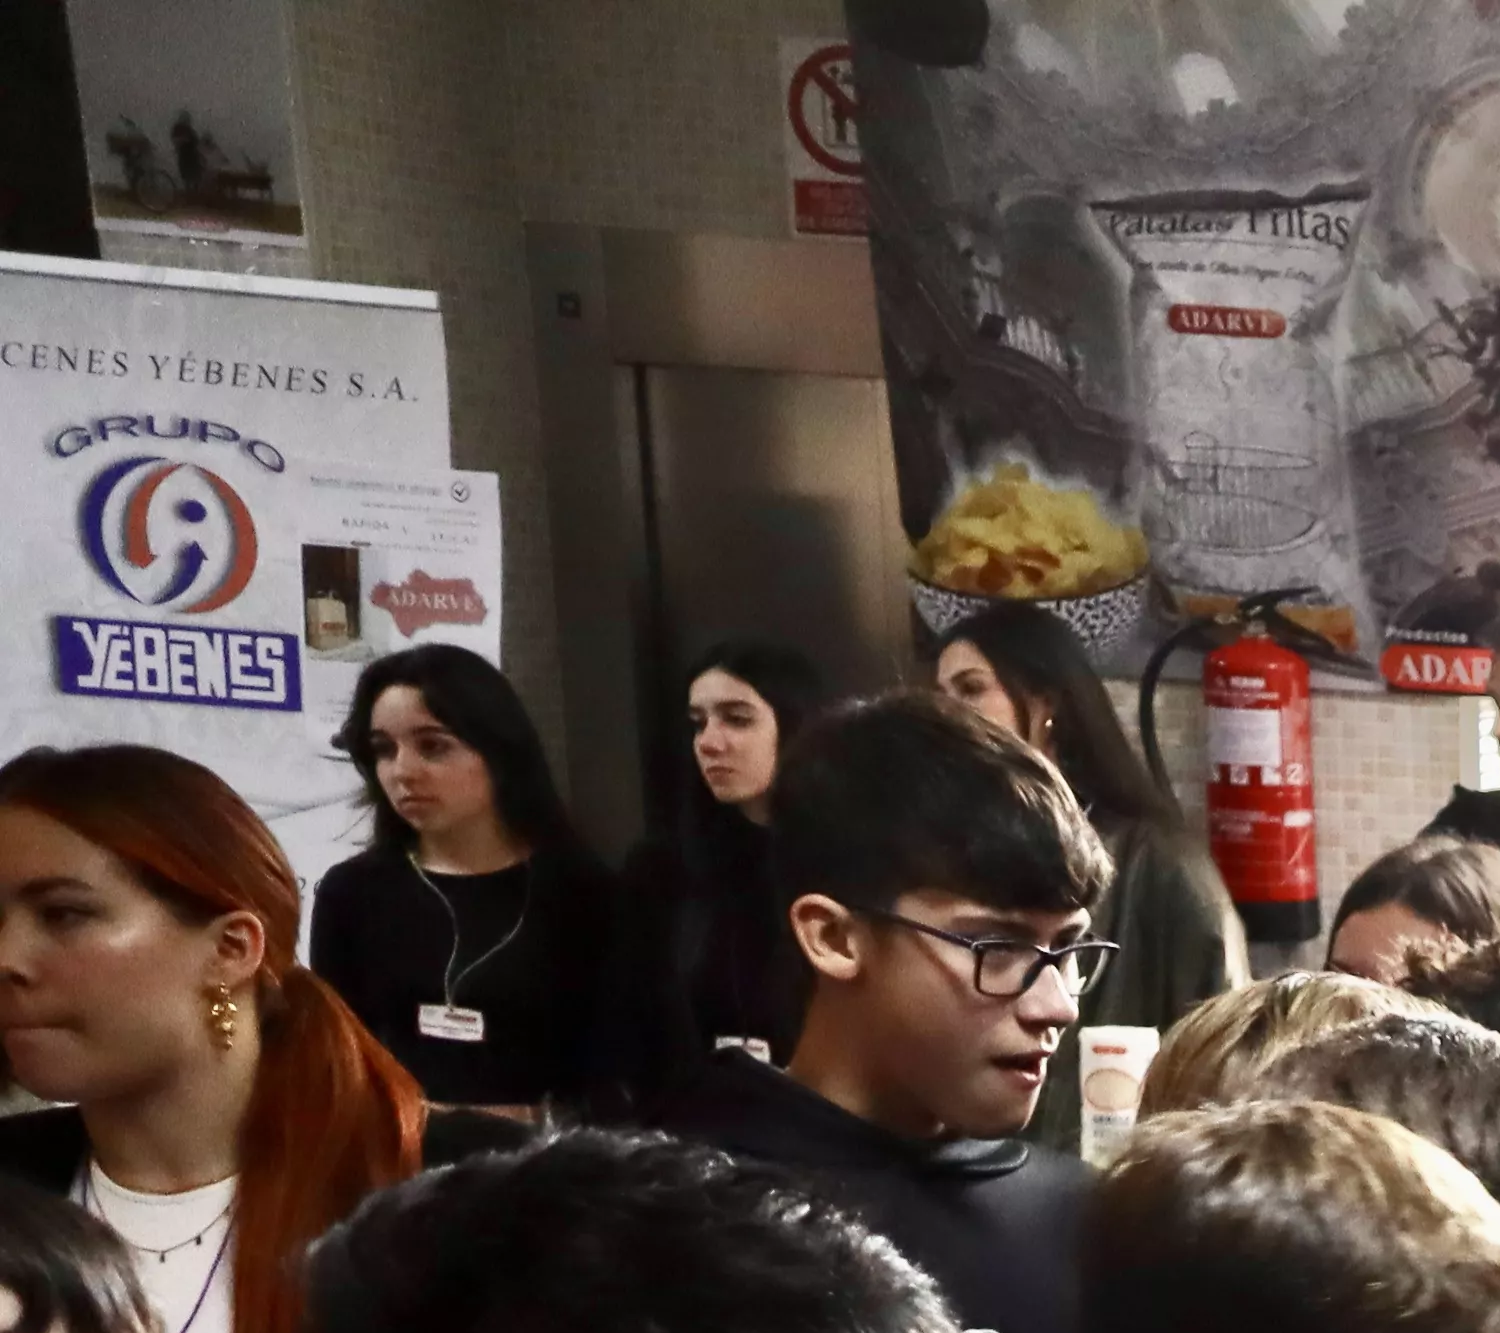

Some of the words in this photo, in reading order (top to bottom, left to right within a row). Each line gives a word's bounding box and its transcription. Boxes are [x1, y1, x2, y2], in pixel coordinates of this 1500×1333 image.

[148, 350, 328, 396] YÉBENES
[53, 413, 286, 474] GRUPO
[387, 588, 479, 612] ADARVE
[1385, 625, 1469, 644] Productos
